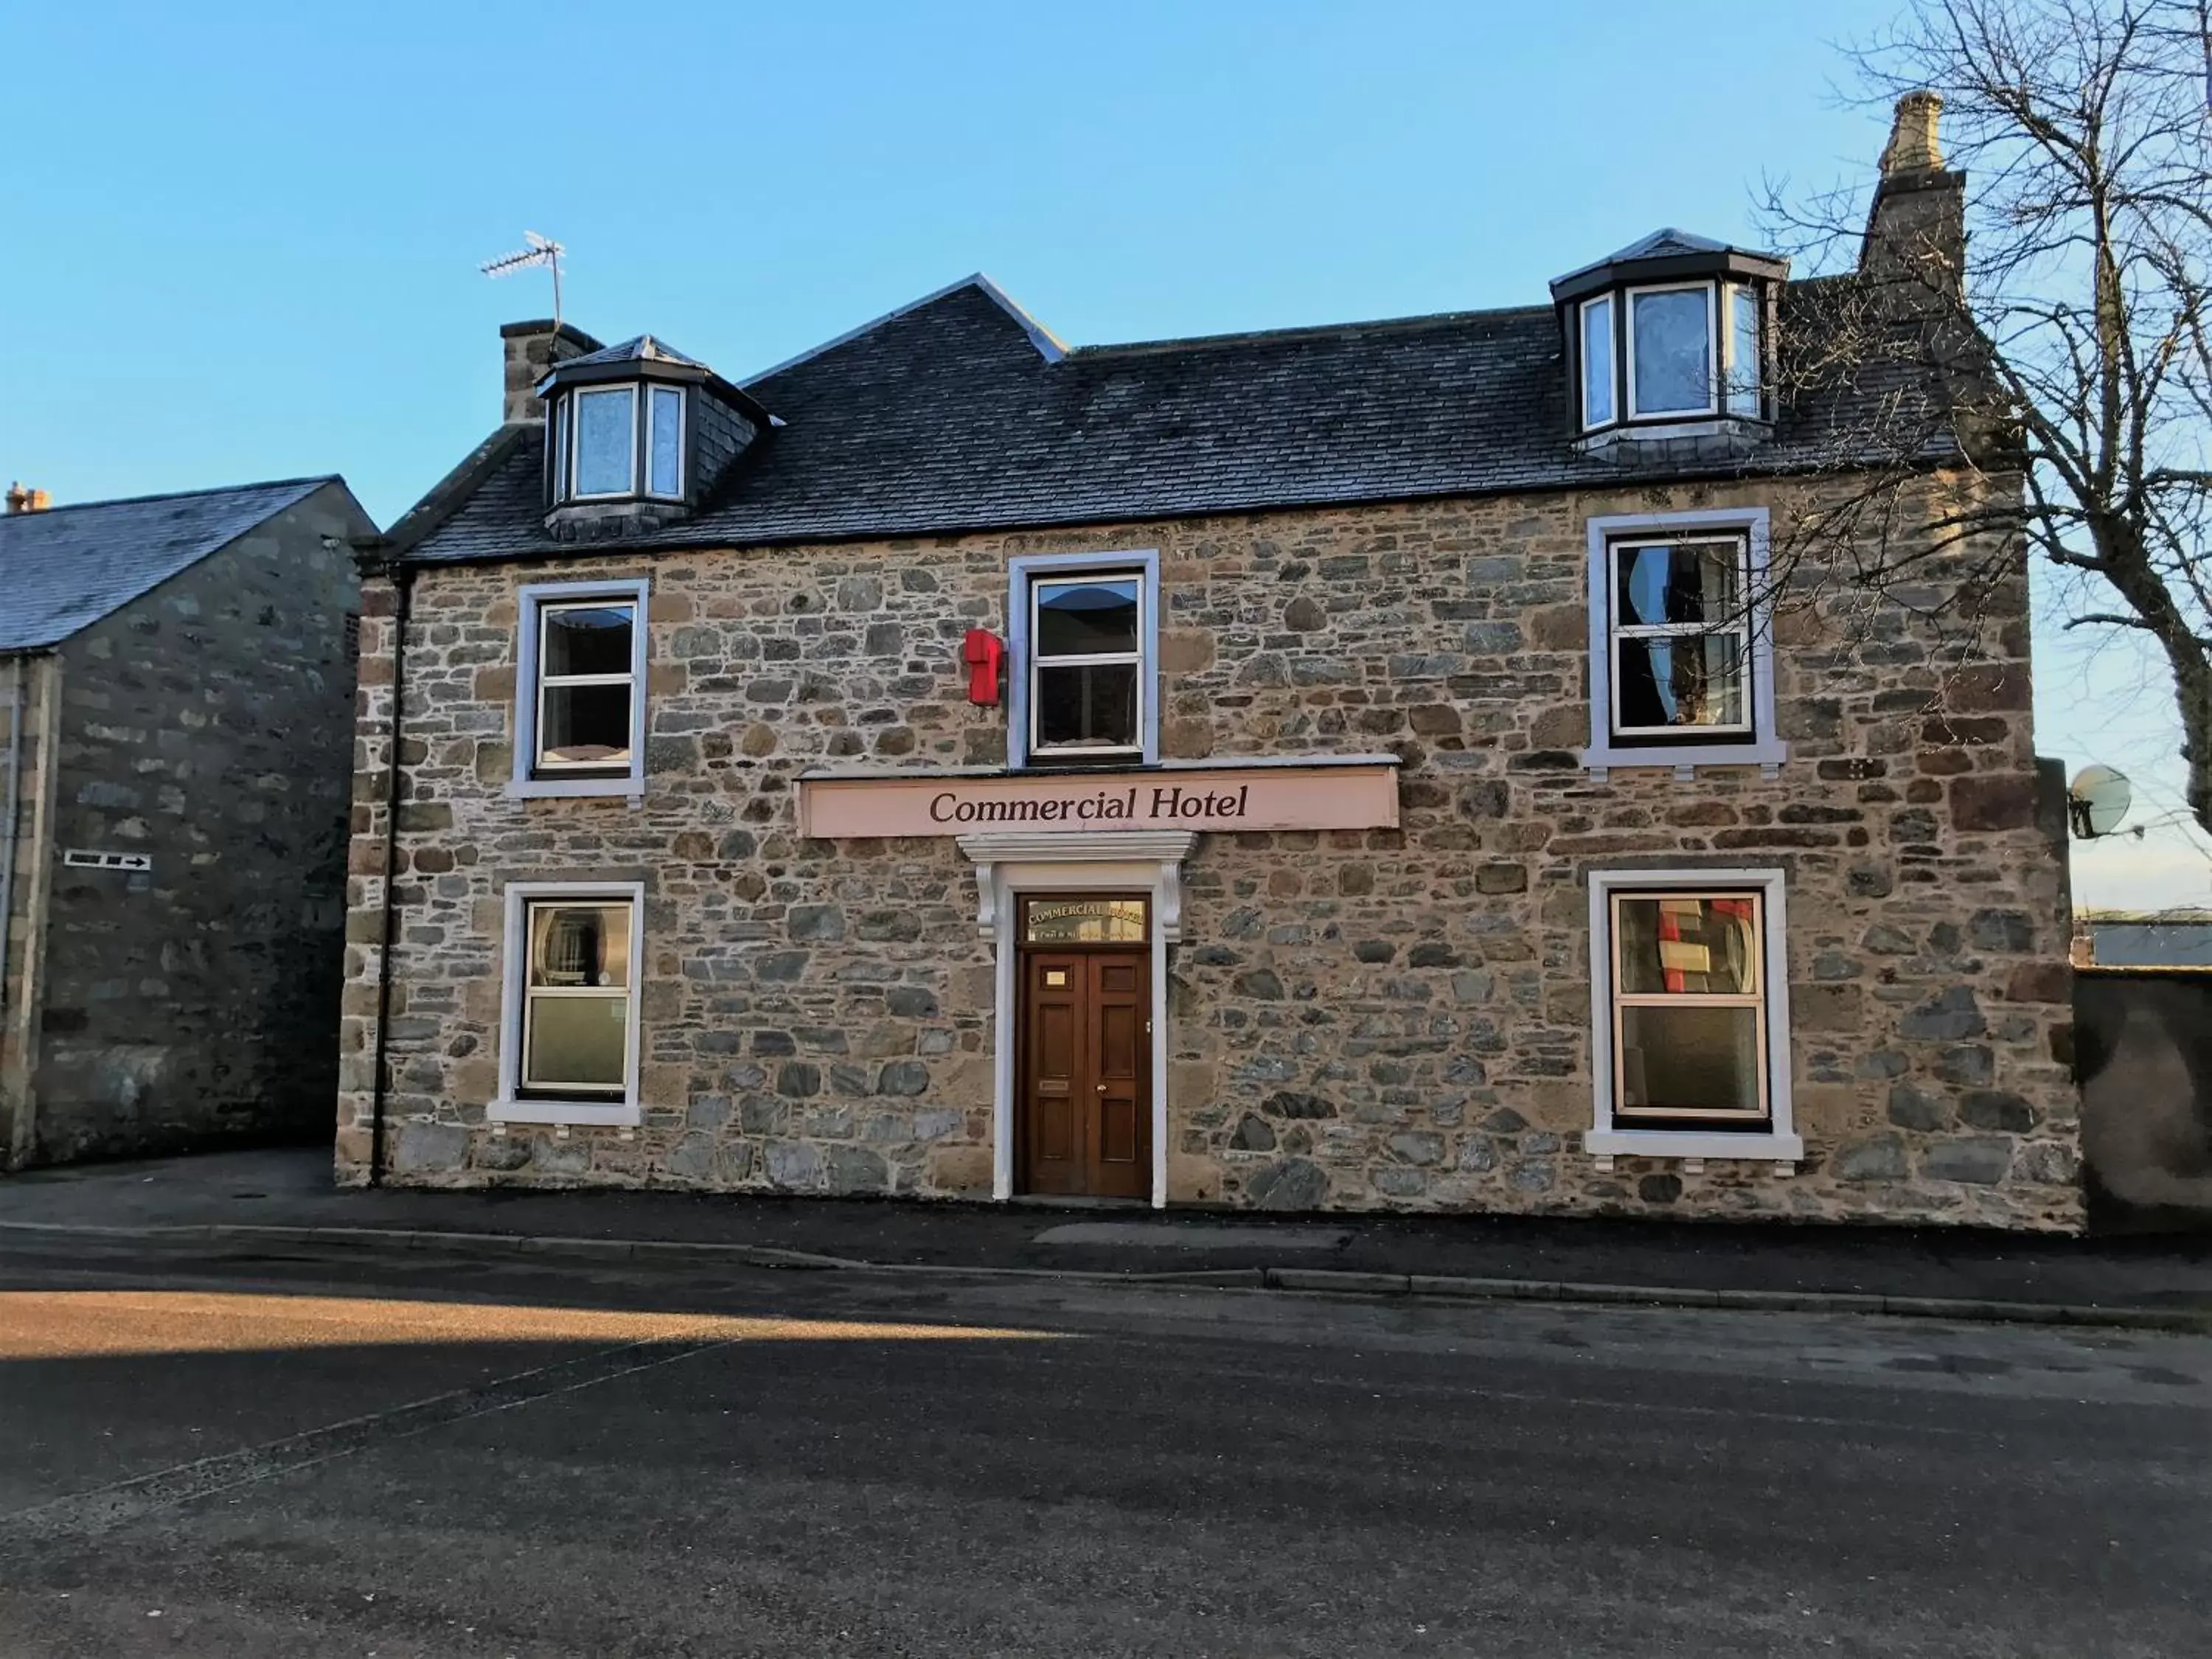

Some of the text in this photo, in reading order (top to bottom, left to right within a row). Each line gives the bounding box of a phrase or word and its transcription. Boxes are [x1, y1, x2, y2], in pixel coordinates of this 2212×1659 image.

[930, 785, 1248, 822] Commercial Hotel
[1029, 904, 1103, 925] COMMERCIAL
